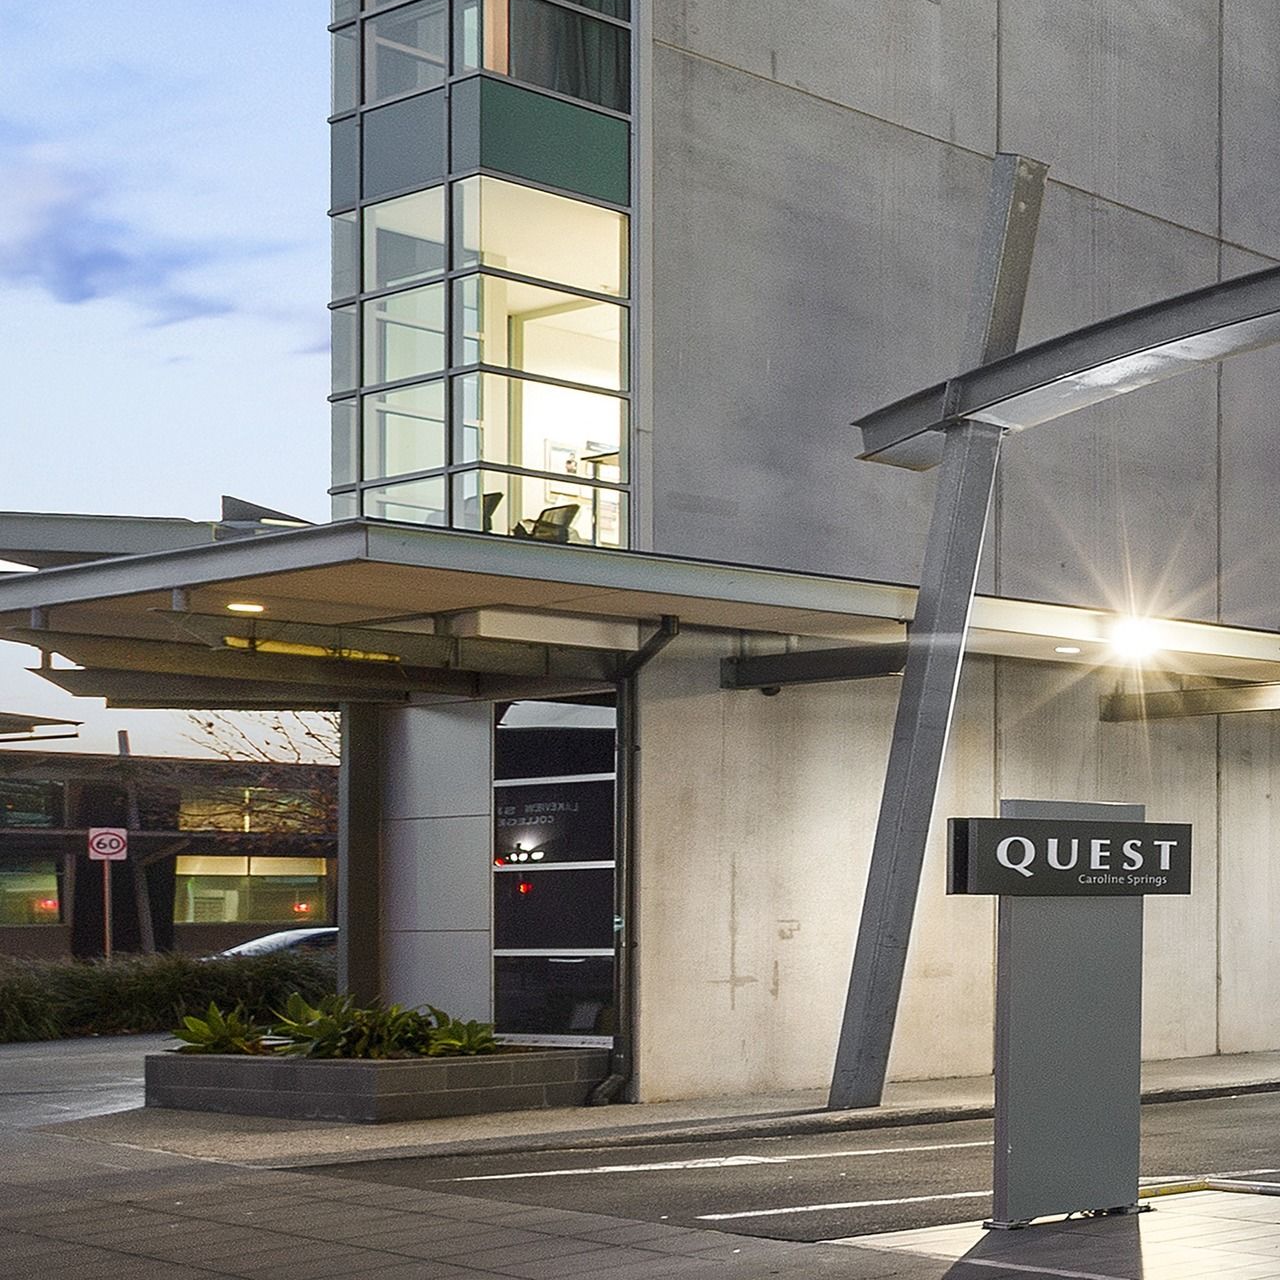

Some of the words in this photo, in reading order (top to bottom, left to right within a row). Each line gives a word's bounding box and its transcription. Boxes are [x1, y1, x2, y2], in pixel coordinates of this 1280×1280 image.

[96, 838, 120, 849] 60
[996, 836, 1178, 877] QUEST
[1078, 873, 1125, 885] Caroline
[1127, 874, 1167, 887] Springs
